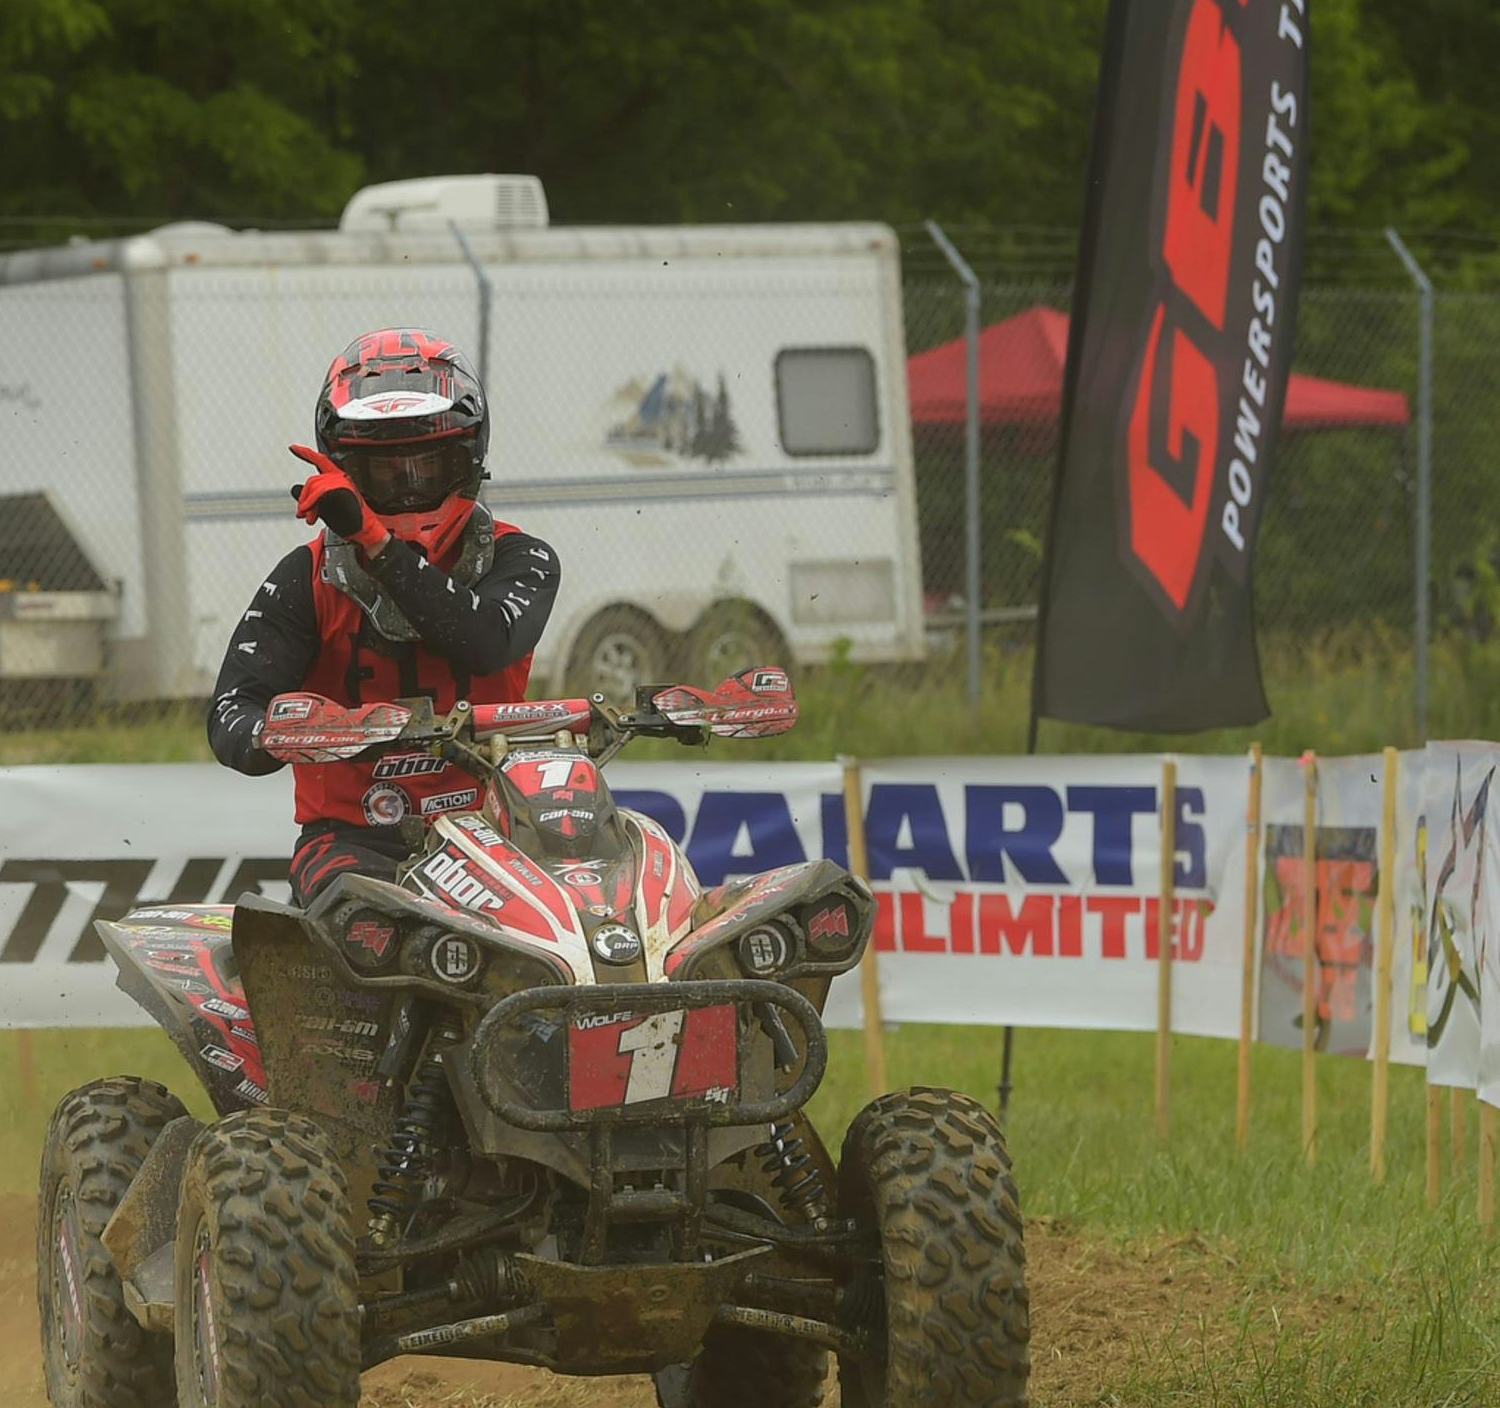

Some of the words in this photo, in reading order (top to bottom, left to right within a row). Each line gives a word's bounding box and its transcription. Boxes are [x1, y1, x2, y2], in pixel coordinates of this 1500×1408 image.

[1221, 82, 1298, 551] POWERSPORTS
[1278, 0, 1304, 49] T
[1127, 0, 1248, 611] GB
[537, 760, 574, 790] 1
[426, 794, 474, 811] ACTION
[540, 808, 595, 823] can-am
[873, 889, 1215, 962] LIMITED
[576, 1010, 633, 1030] WOLFE
[618, 1009, 685, 1105] 1
